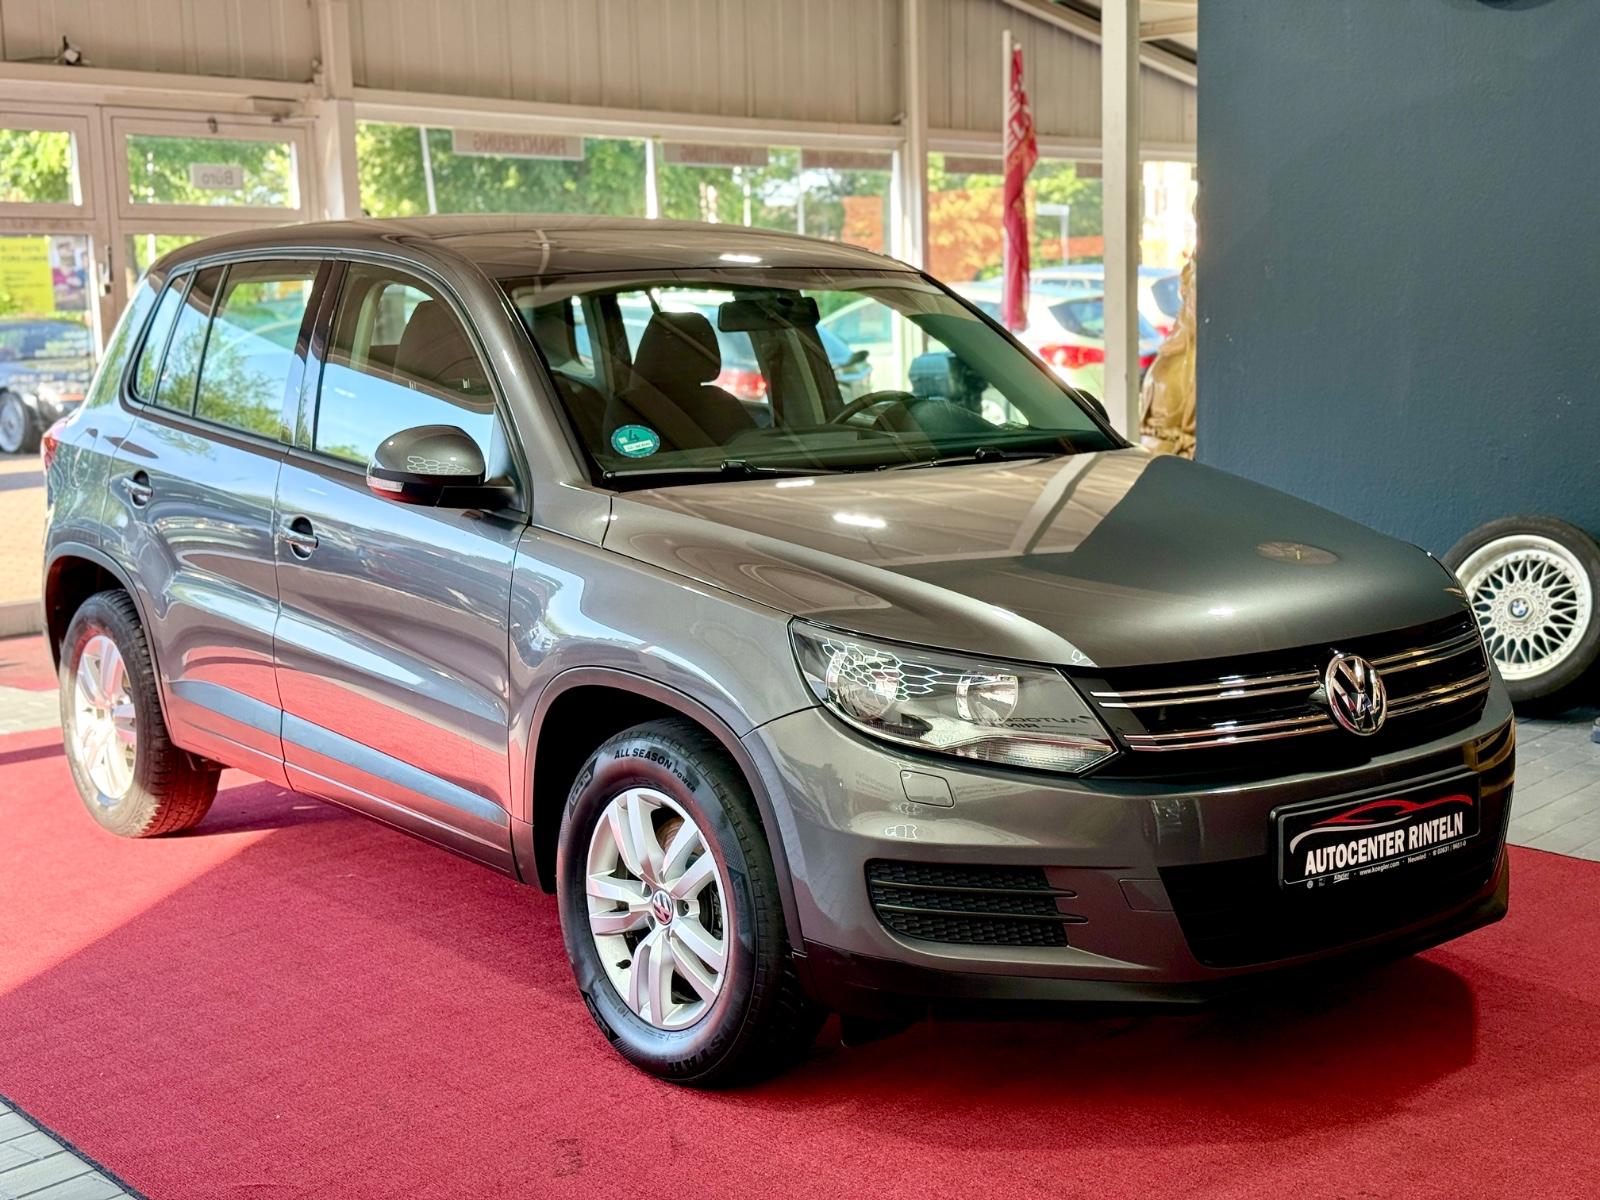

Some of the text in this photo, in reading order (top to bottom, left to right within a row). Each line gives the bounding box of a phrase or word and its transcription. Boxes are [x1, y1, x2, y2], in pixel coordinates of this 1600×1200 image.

[614, 747, 697, 793] ALL SEASON POWER
[1305, 811, 1463, 876] AUTOCENTER RINTELN
